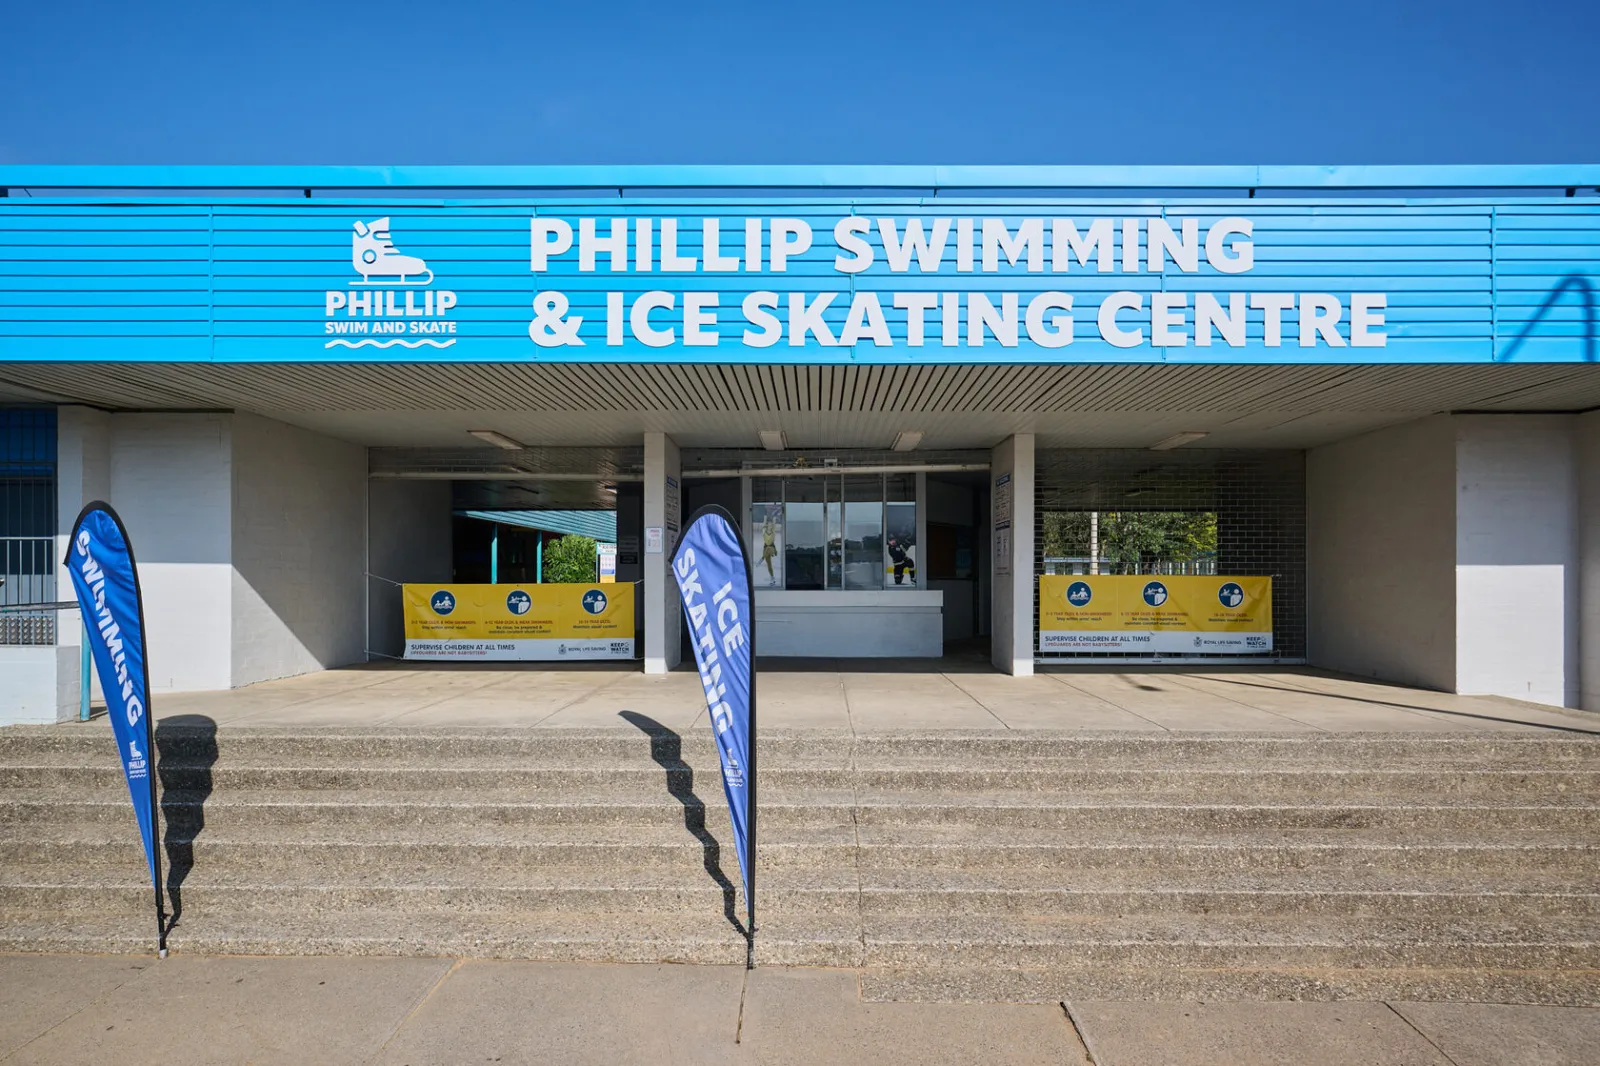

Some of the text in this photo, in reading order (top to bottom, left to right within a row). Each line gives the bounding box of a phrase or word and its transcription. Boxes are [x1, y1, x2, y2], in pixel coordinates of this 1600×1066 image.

[530, 216, 1255, 274] PHILLIP SWIMMING
[325, 290, 458, 317] PHILLIP
[325, 321, 457, 334] SWIM AND SKATE
[528, 290, 1388, 348] & ICE SKATING CENTRE
[76, 529, 144, 728] SWIMMING
[677, 547, 734, 737] SKATING
[712, 580, 745, 658] ICE
